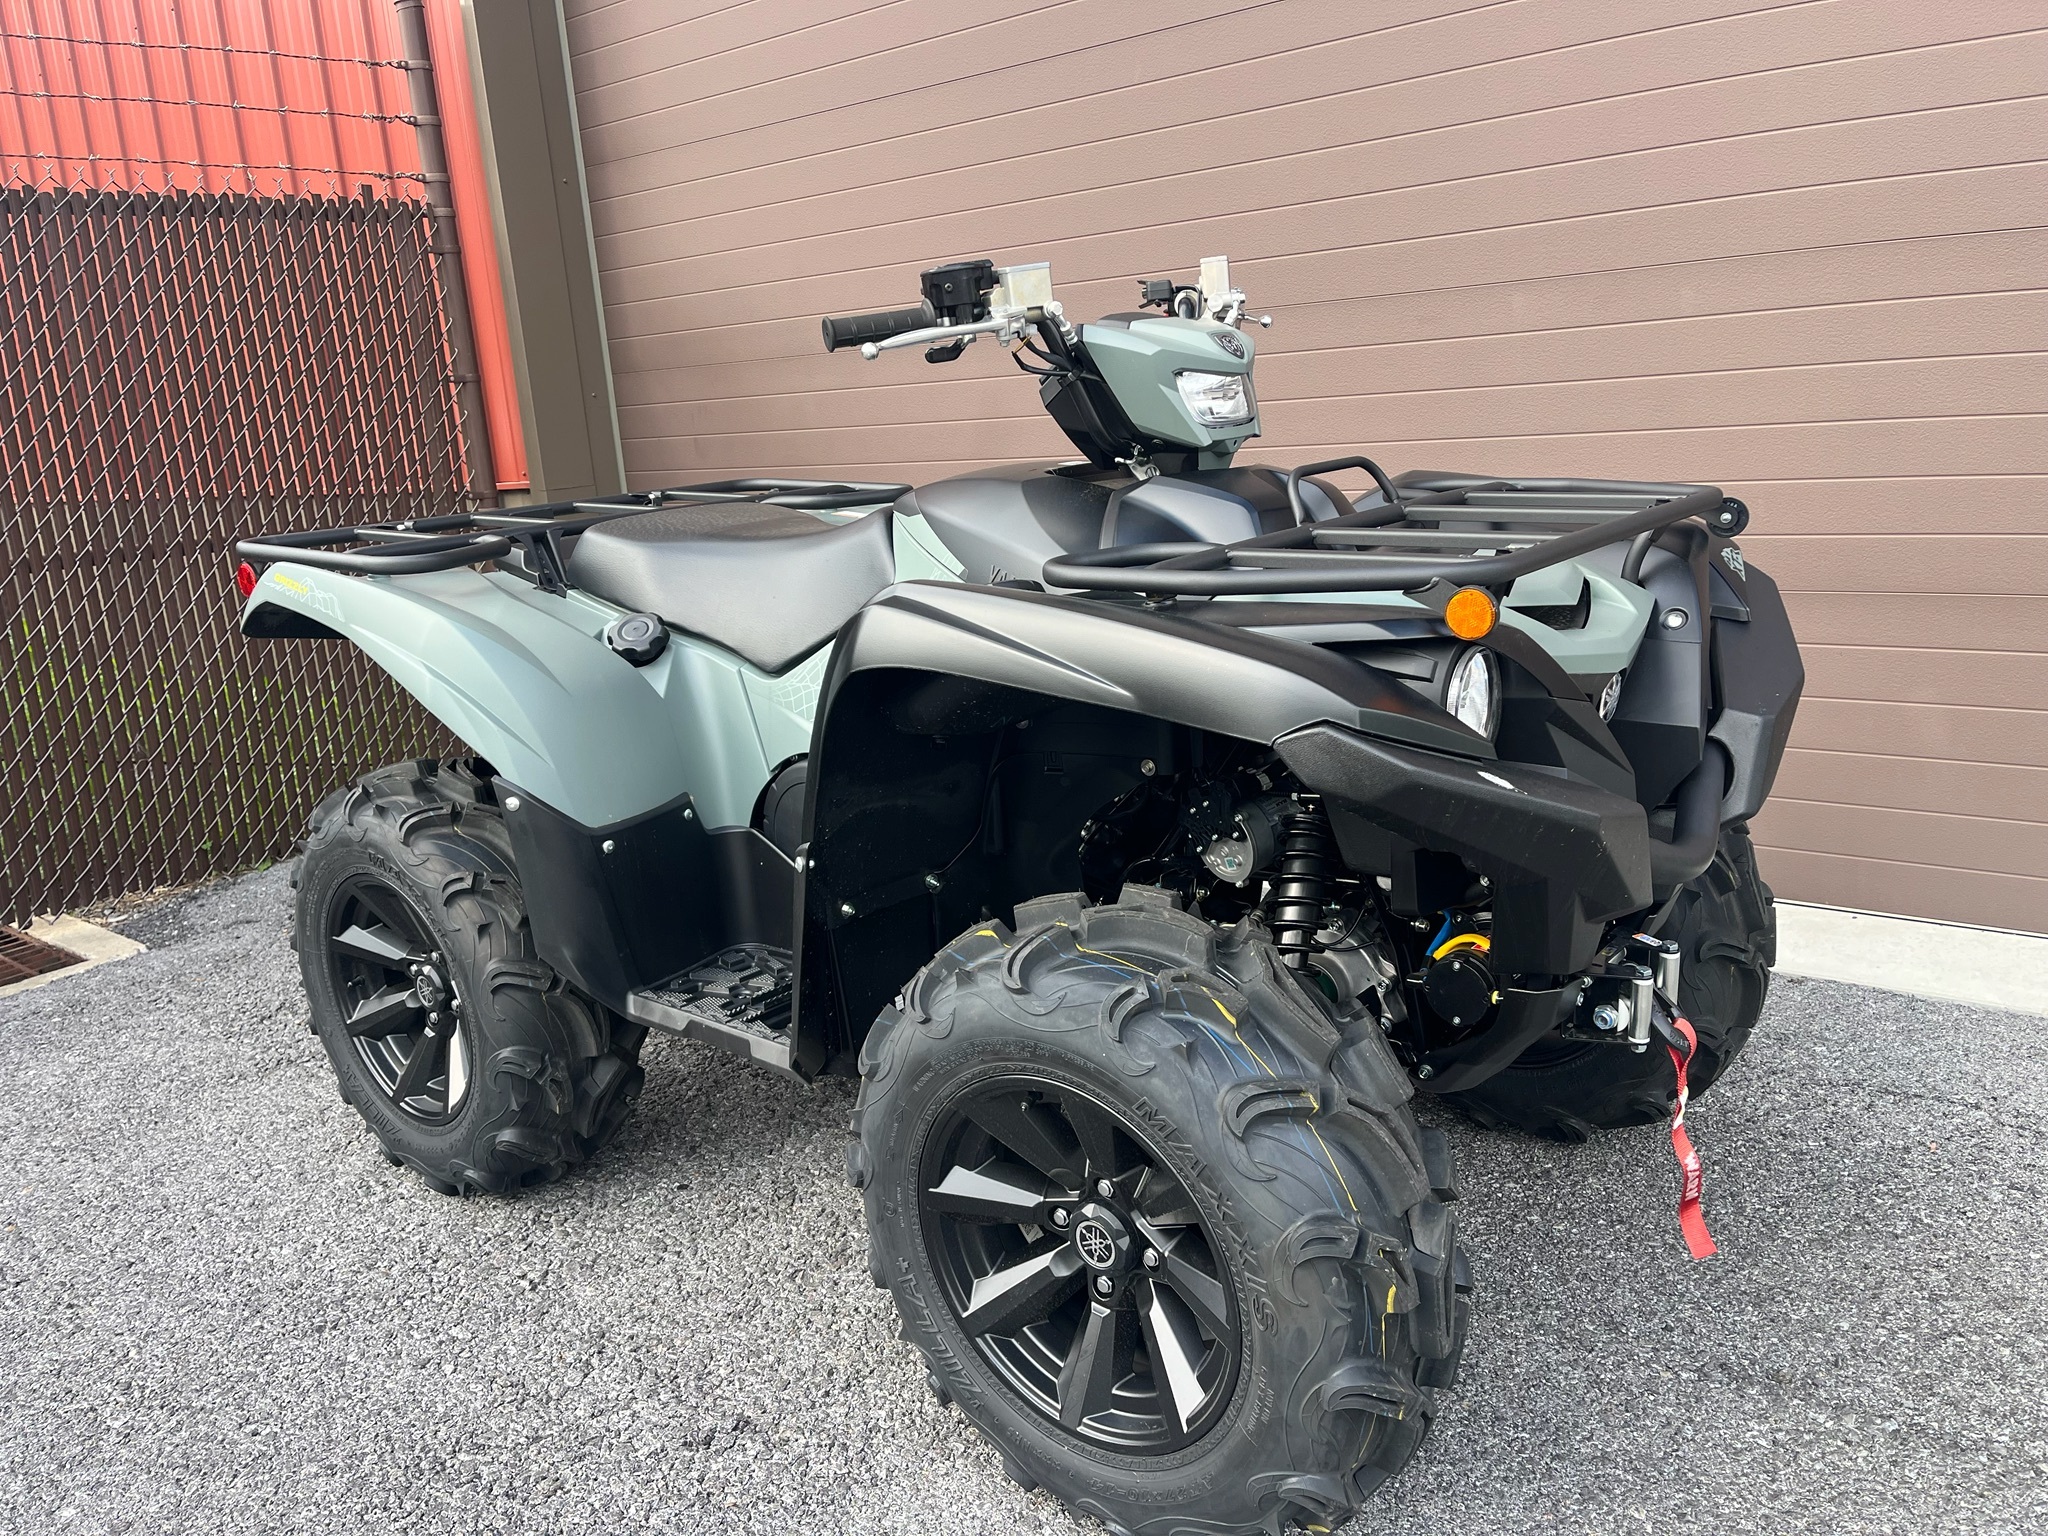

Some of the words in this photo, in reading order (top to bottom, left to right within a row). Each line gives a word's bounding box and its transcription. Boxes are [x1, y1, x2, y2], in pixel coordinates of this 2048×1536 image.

[274, 572, 309, 595] GRIZZLY
[1684, 1151, 1700, 1201] WARN
[1131, 1096, 1279, 1337] MAXXIS
